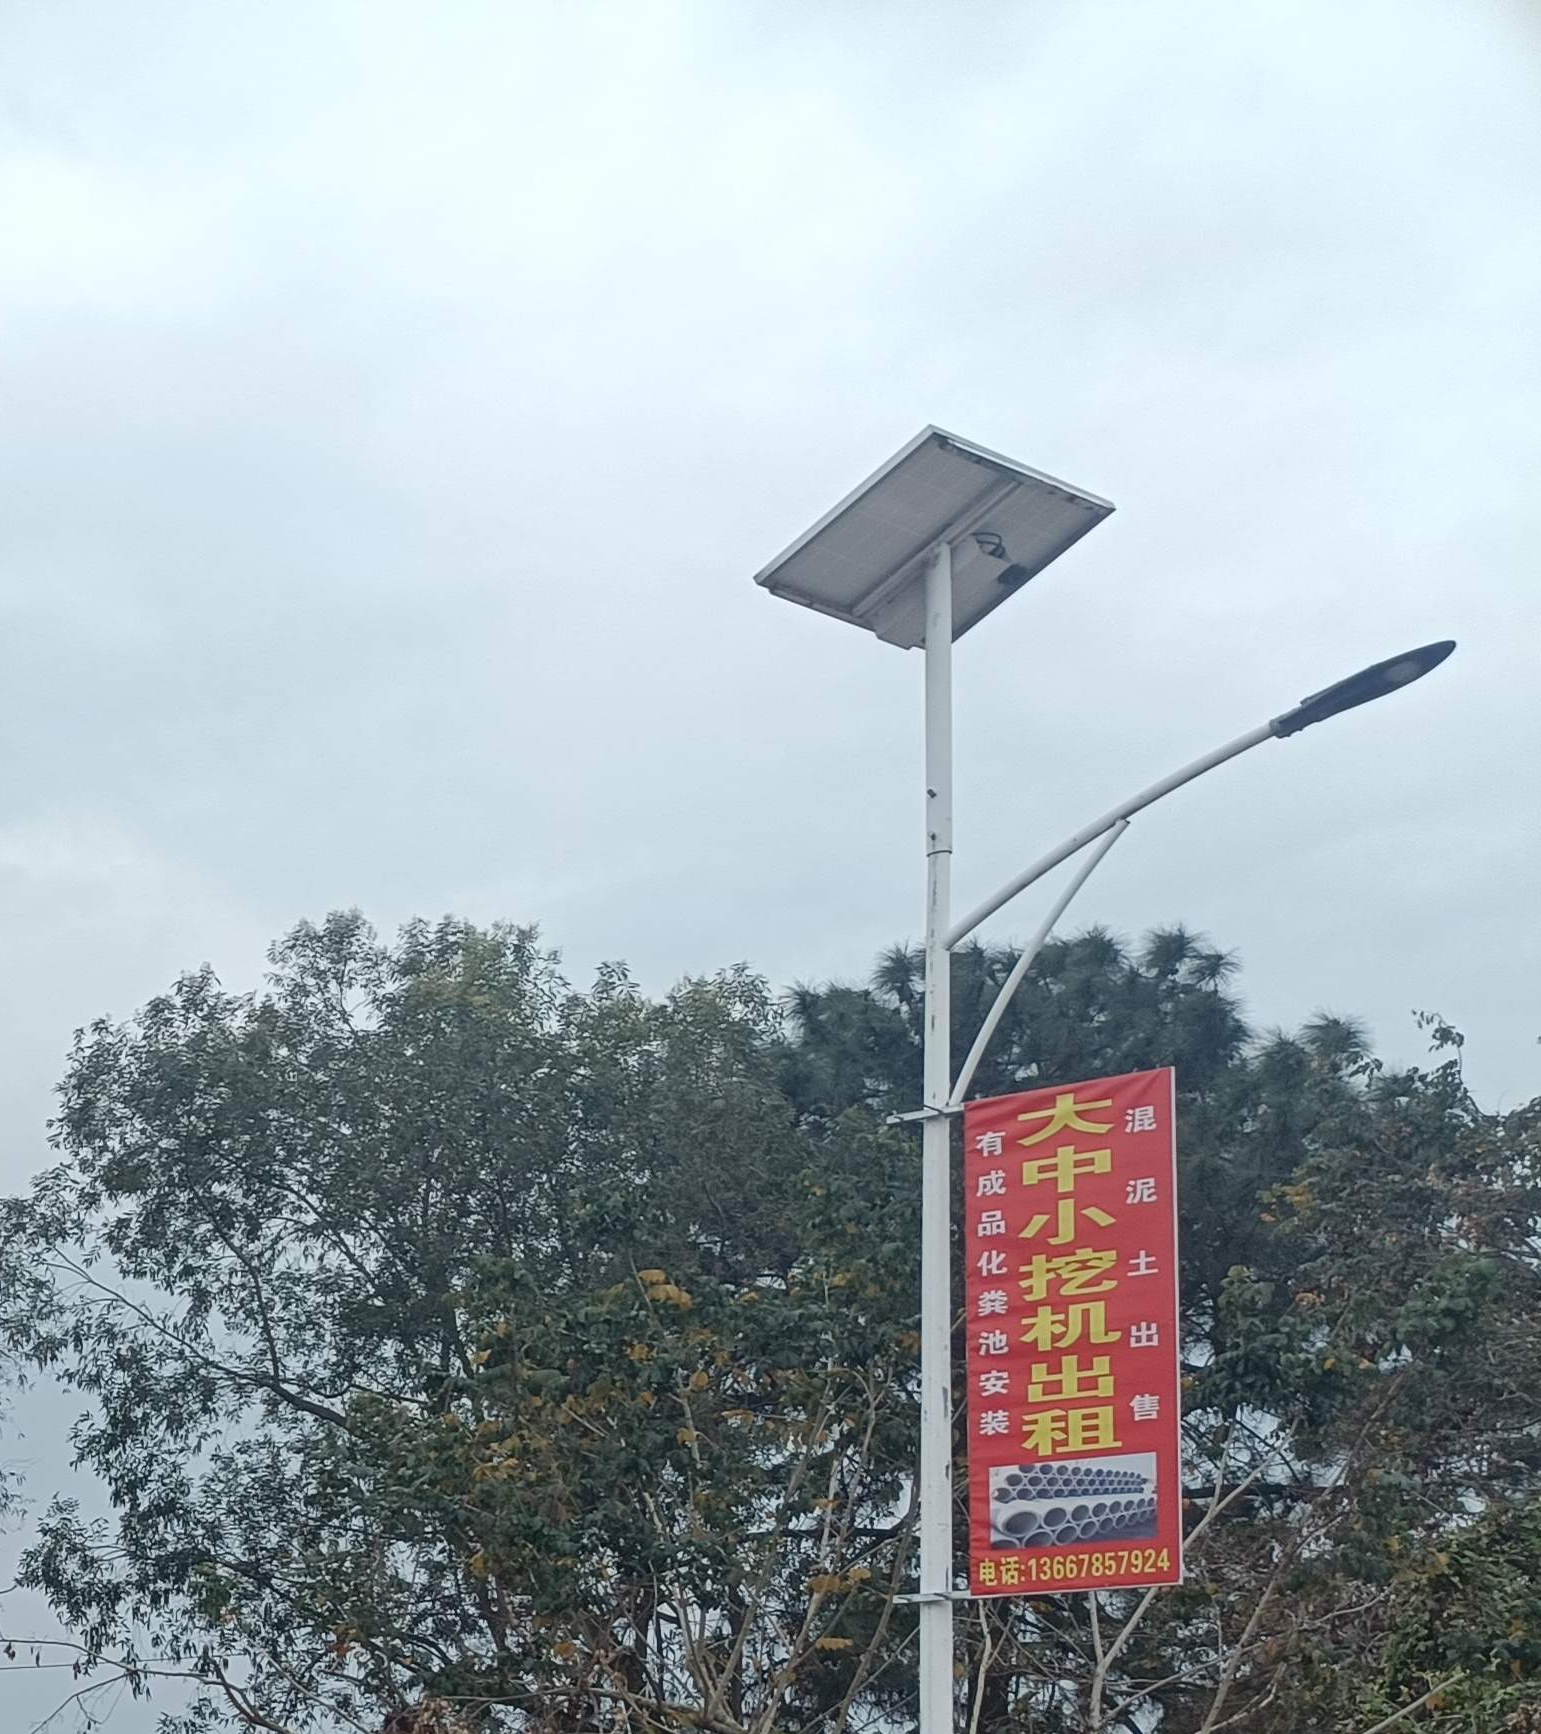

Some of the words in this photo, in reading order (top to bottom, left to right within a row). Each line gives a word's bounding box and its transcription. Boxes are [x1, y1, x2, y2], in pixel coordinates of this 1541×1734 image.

[974, 1130, 1010, 1436] 有成品化粪池安装
[1016, 1092, 1123, 1457] 大中小挖机出租
[1124, 1104, 1161, 1422] 混泥土出售
[978, 1547, 1171, 1587] 电话:13667857924
